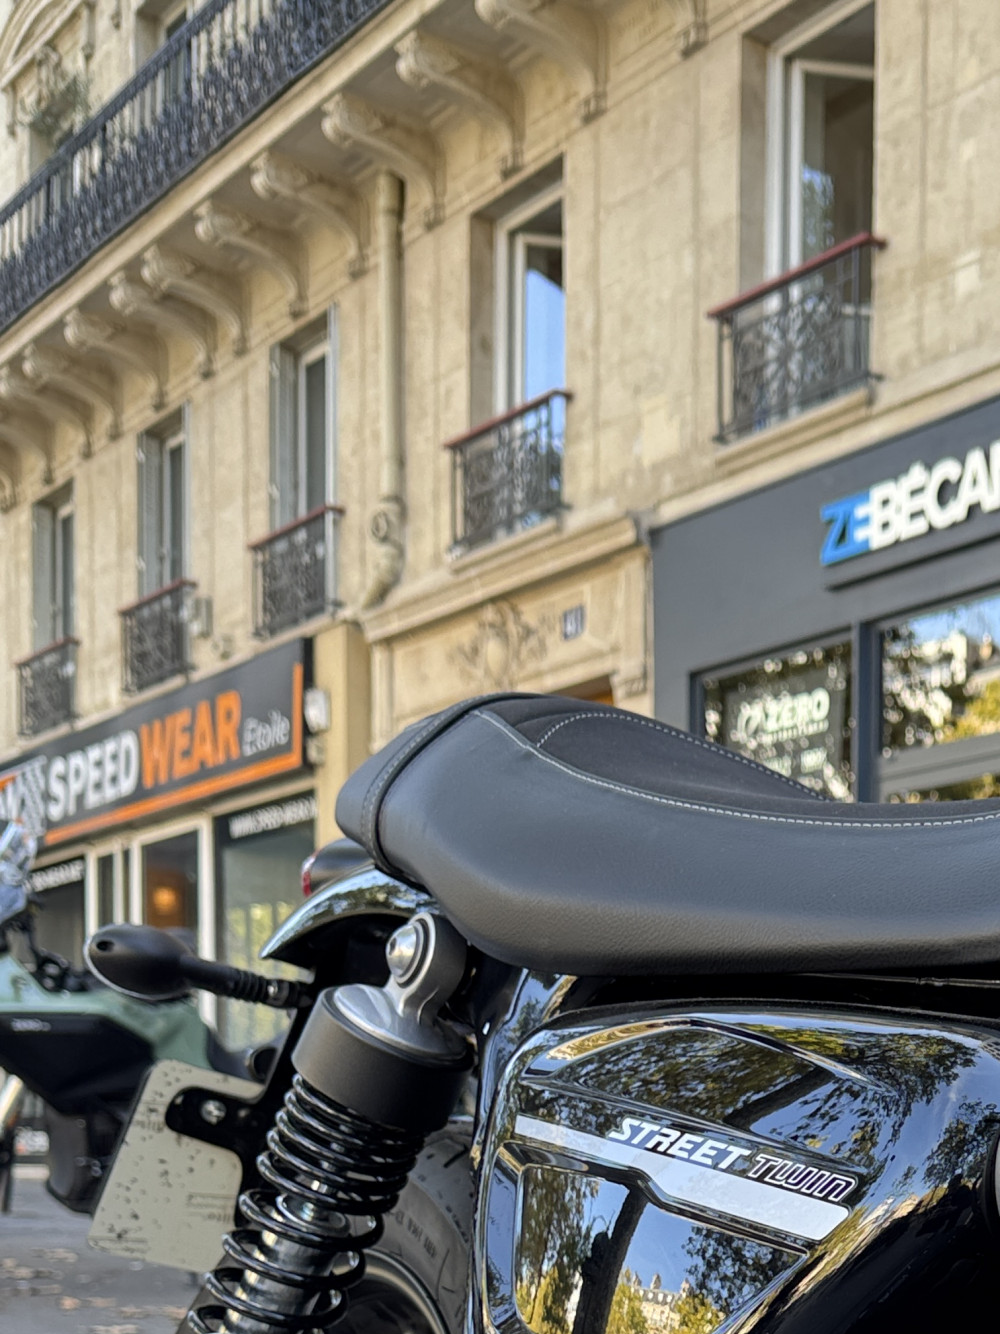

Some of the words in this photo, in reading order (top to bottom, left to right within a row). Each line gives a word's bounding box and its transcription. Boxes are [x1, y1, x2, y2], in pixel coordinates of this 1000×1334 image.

[764, 687, 831, 733] ZERO
[606, 1117, 751, 1170] STREET
[748, 1152, 857, 1203] TWIN
